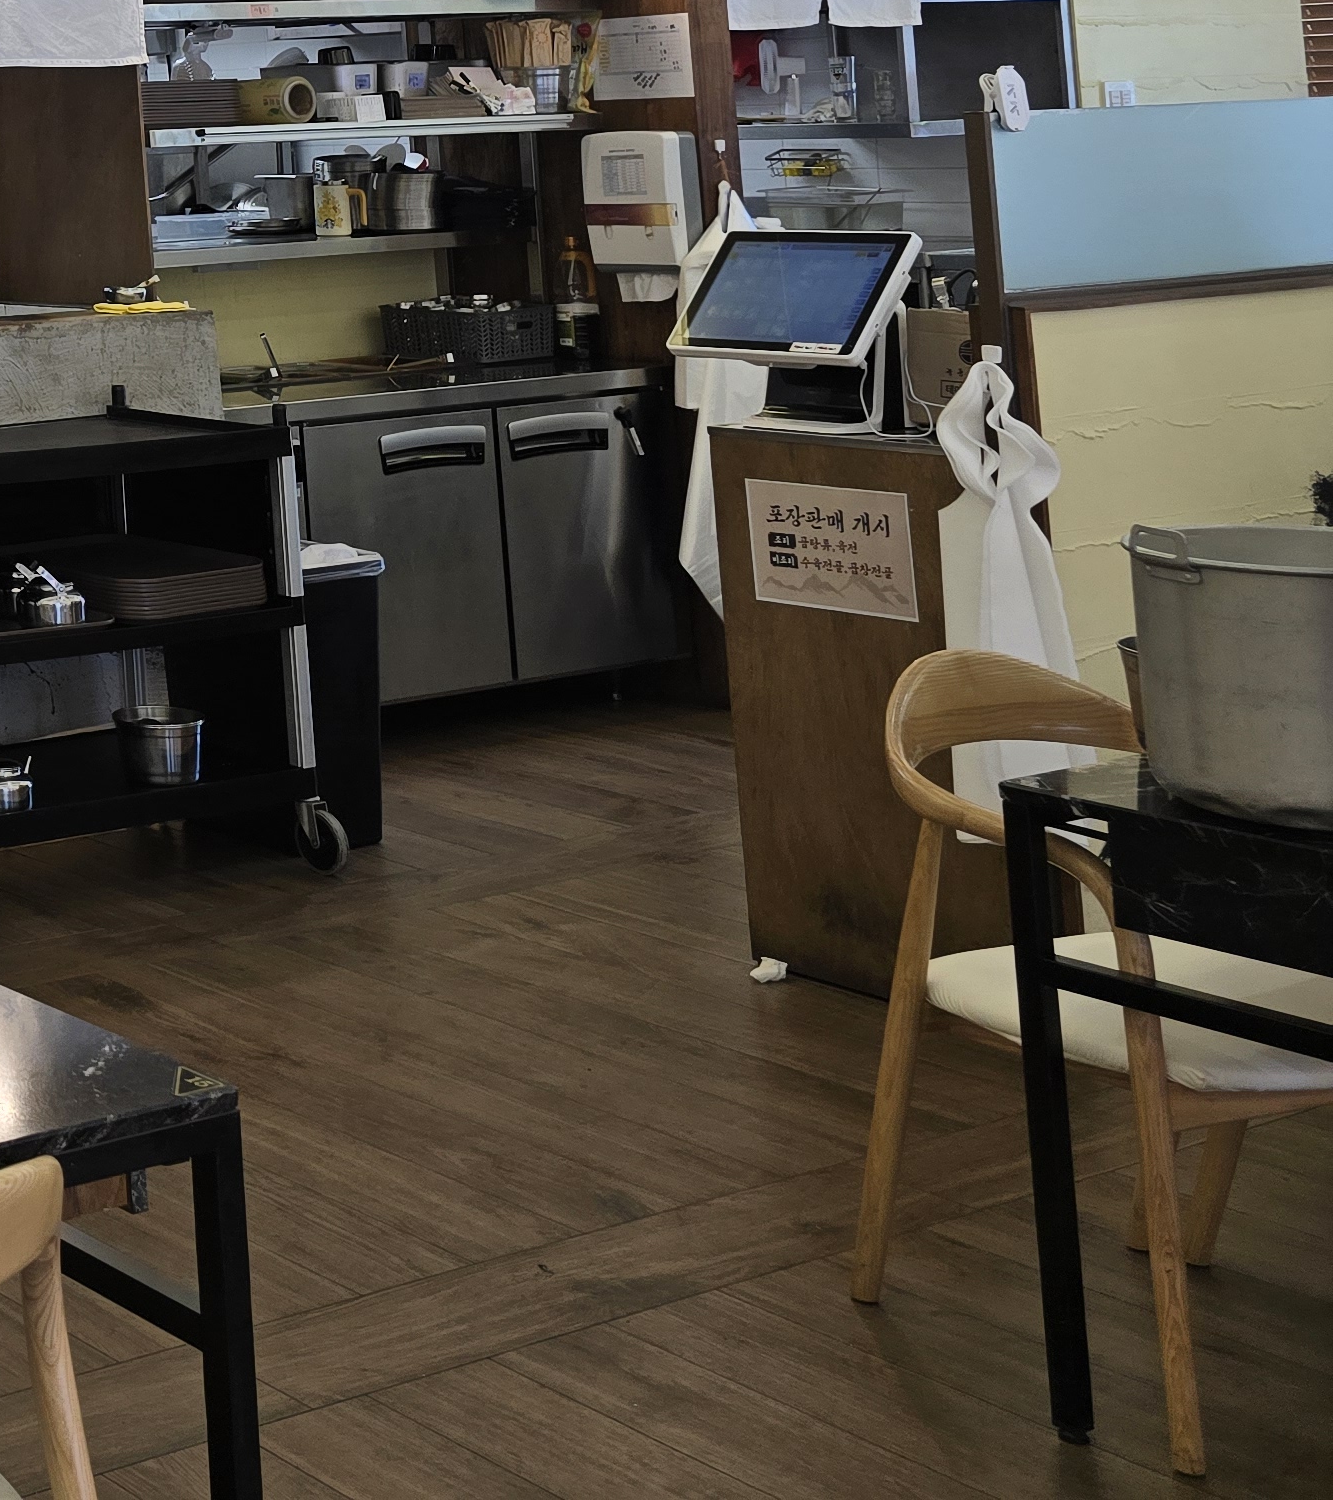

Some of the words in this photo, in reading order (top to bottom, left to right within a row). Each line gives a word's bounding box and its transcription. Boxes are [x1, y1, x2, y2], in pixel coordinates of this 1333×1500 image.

[765, 504, 845, 533] 포장판매
[852, 511, 891, 538] 개시
[773, 535, 790, 546] 조리
